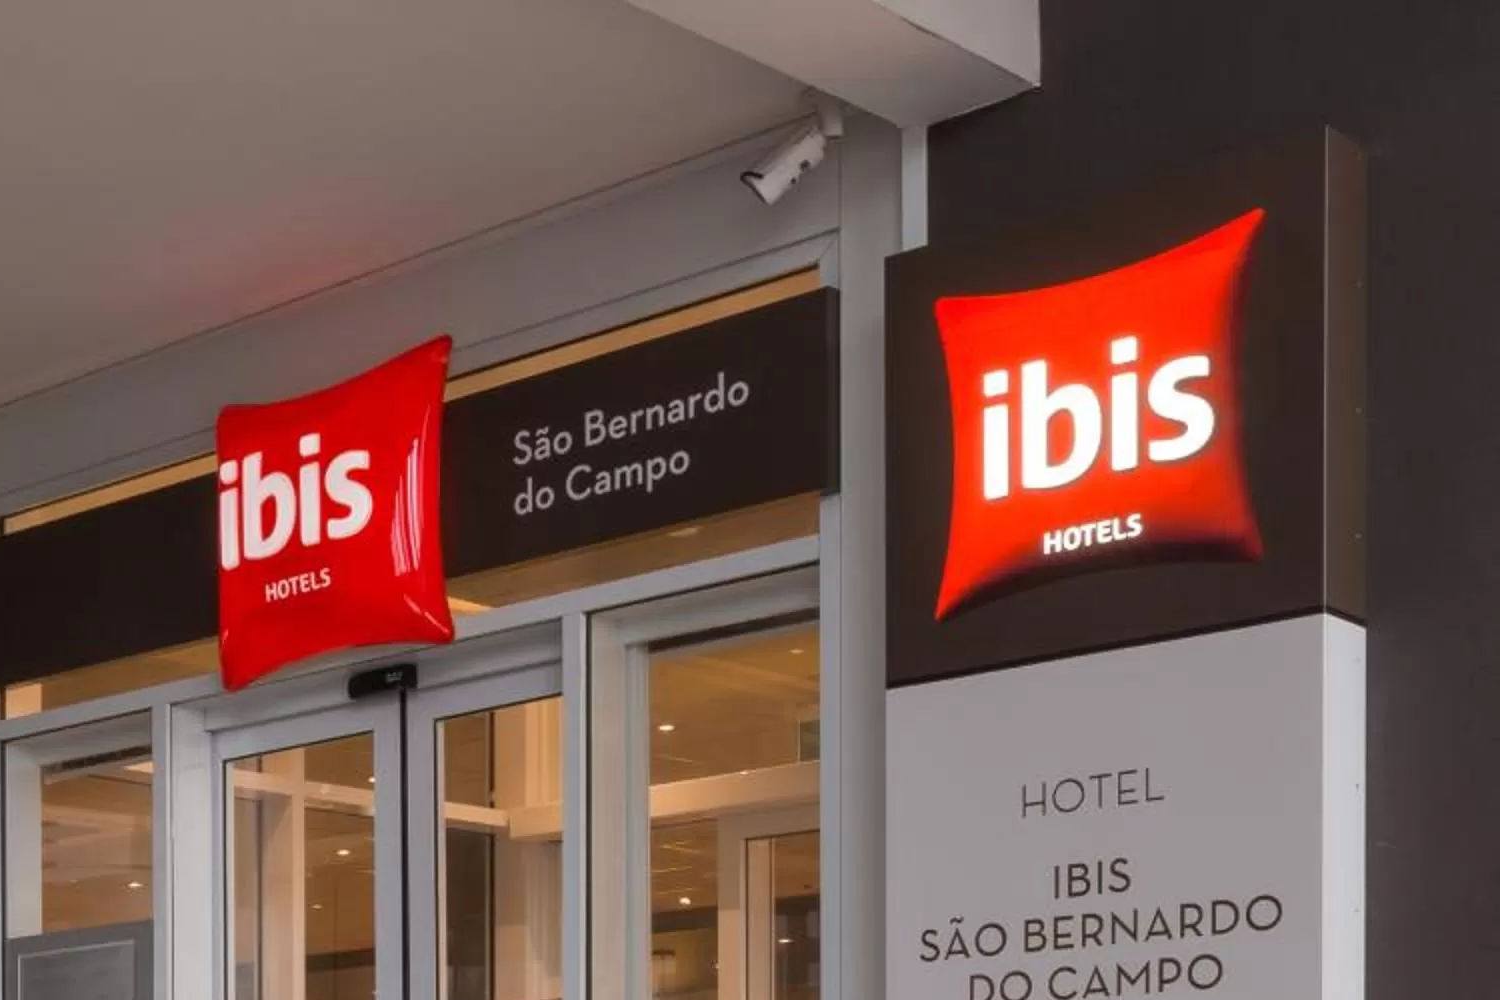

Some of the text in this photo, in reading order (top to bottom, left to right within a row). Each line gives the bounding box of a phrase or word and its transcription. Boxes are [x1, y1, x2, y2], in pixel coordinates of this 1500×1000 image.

[512, 371, 749, 465] São Bernardo
[983, 335, 1215, 501] ibis
[219, 432, 373, 572] ibis
[513, 450, 690, 515] do Campo
[1042, 513, 1143, 555] HOTELS
[265, 567, 332, 603] HOTELS
[1020, 767, 1165, 818] HOTEL
[1053, 857, 1132, 899] IBIS
[919, 894, 1283, 963] SÃO BERNARDO
[1048, 953, 1223, 1000] CAMPO
